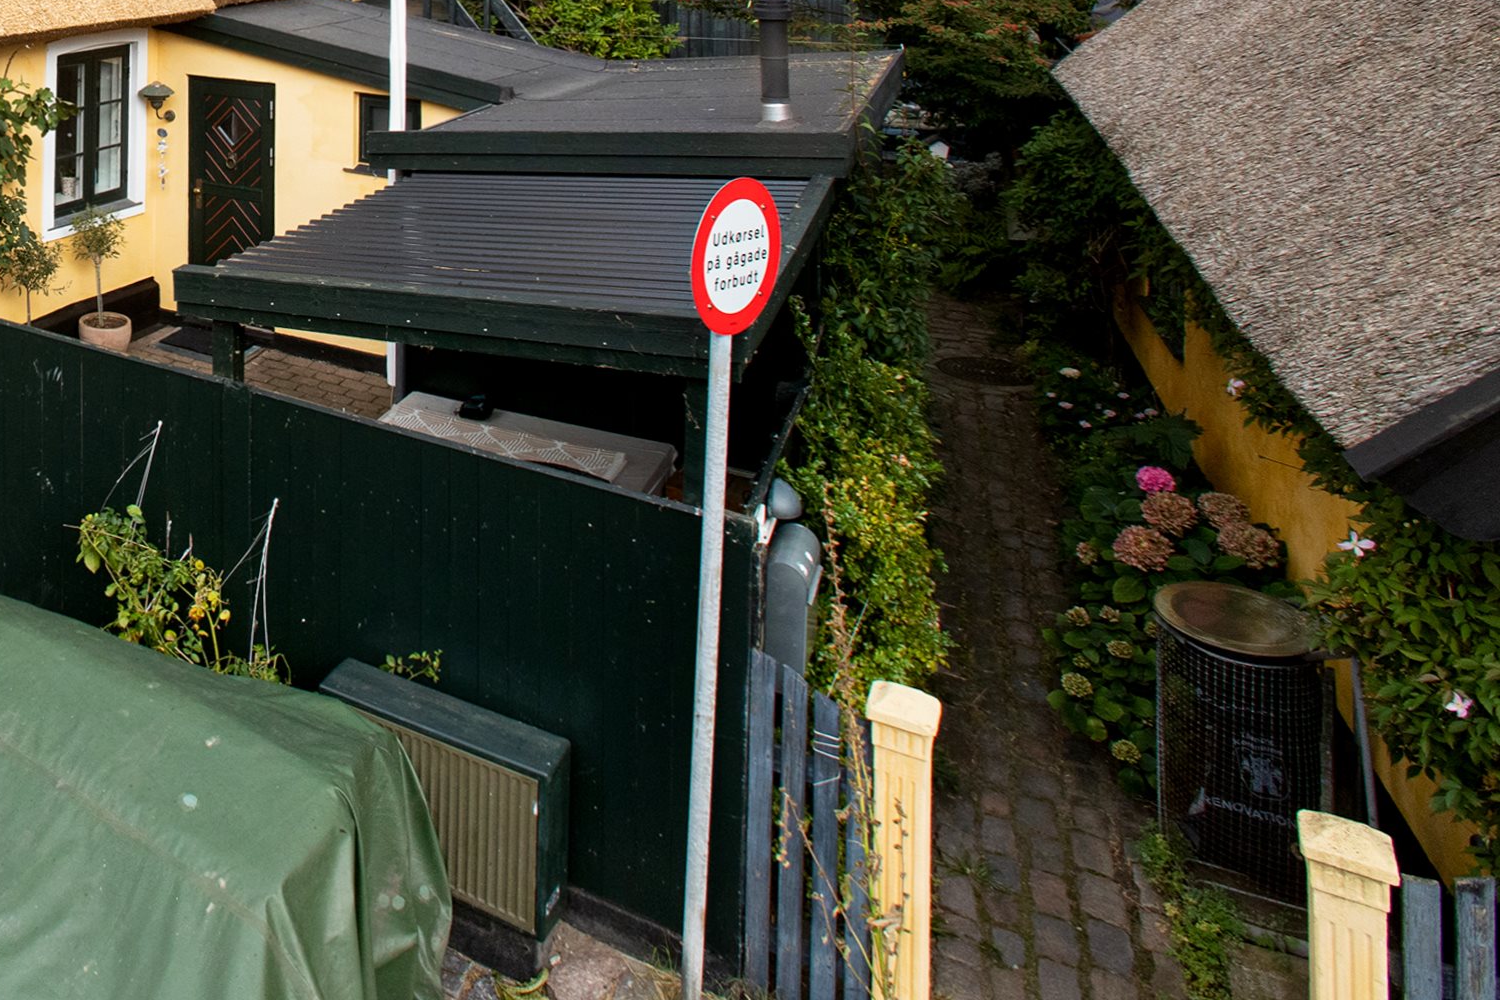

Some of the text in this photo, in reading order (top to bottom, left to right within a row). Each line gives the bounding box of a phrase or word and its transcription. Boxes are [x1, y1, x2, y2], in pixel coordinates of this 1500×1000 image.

[712, 225, 764, 247] Udkørsel
[706, 248, 767, 273] på gågade
[714, 271, 759, 292] forbudt
